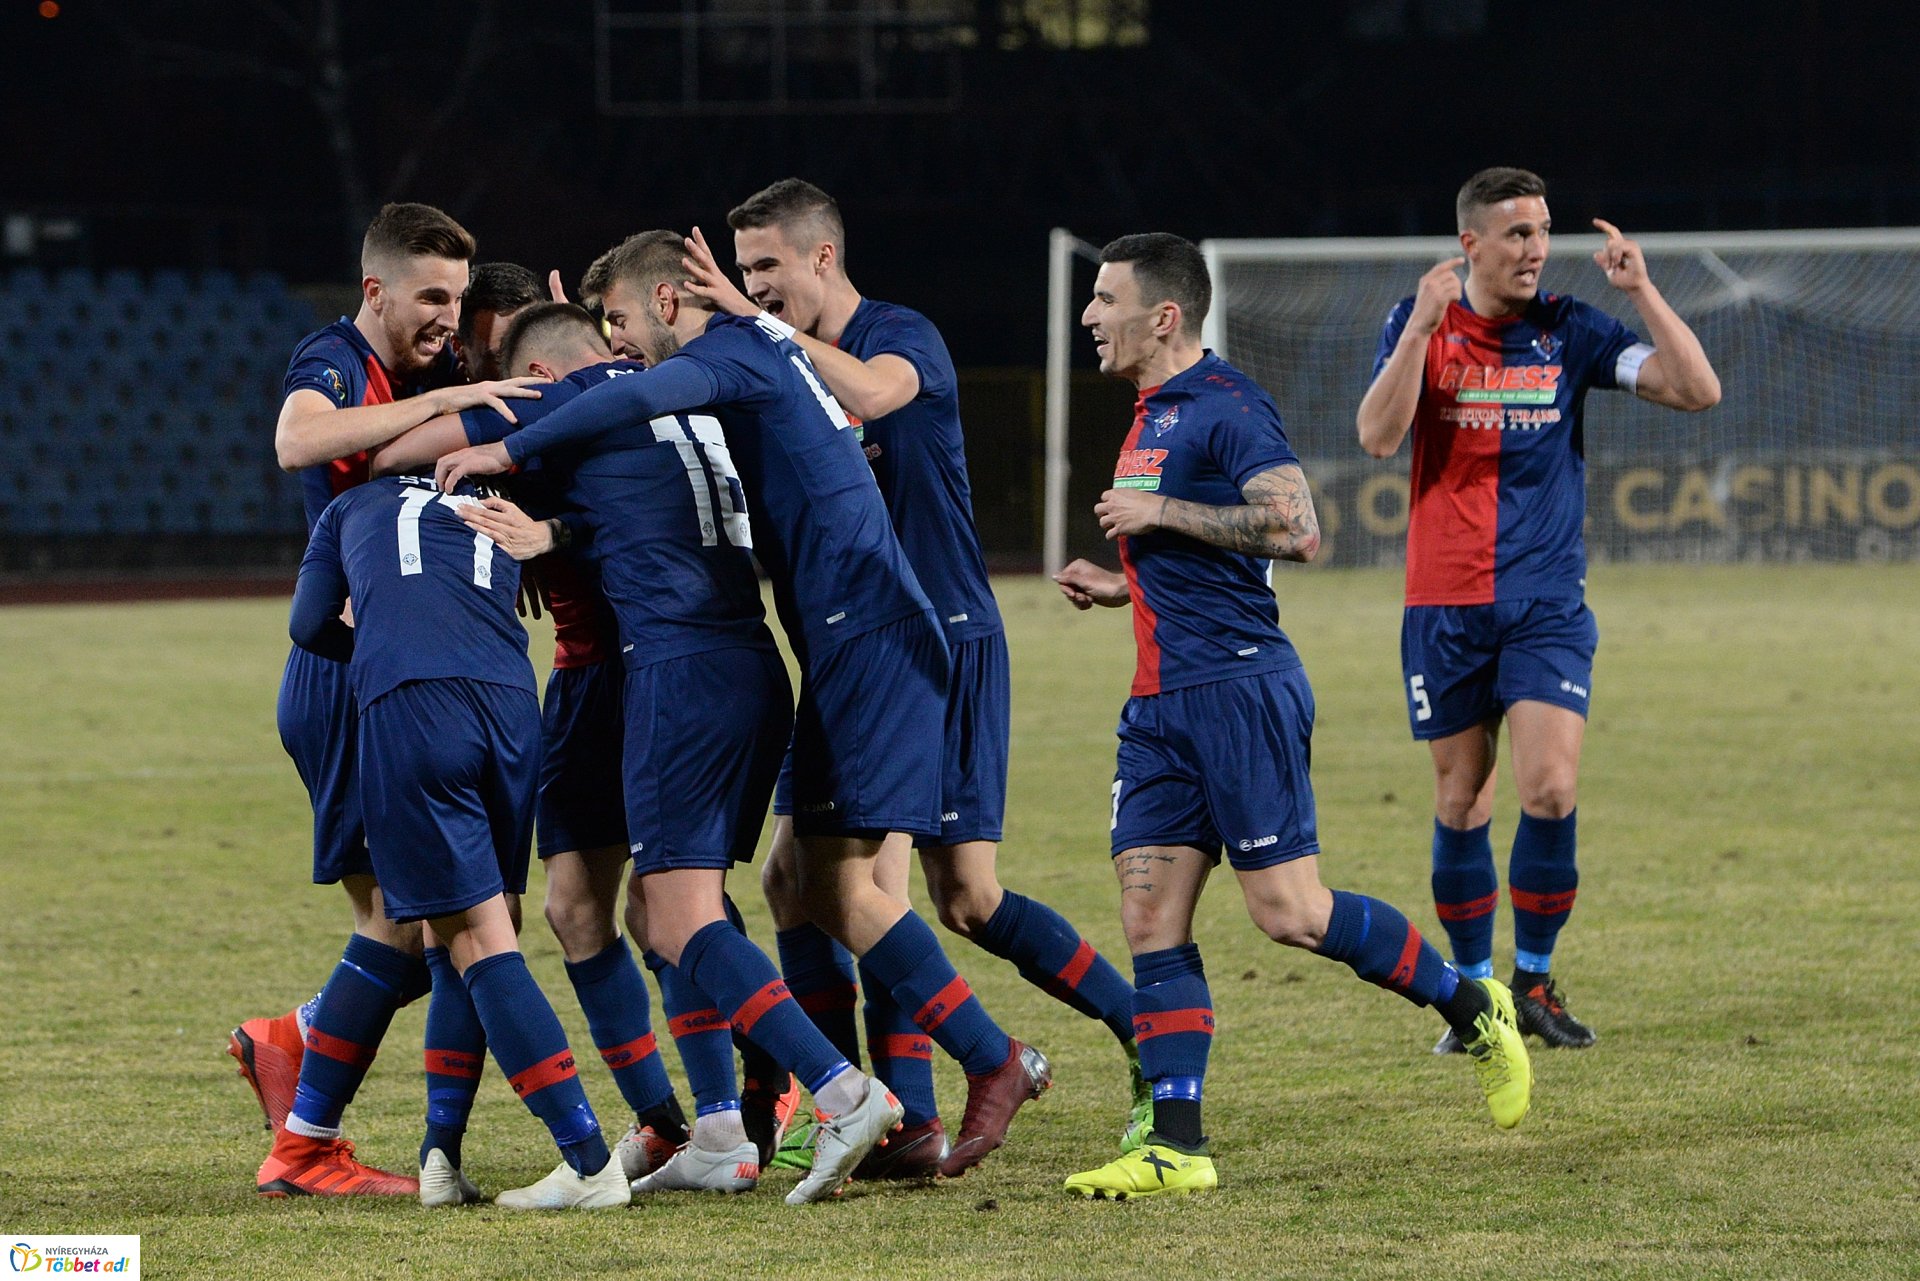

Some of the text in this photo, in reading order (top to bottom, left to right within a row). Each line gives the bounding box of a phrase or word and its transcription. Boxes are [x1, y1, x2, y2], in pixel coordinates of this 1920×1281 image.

[1614, 464, 1920, 532] CASINO
[1410, 673, 1432, 721] 5
[1252, 834, 1278, 848] JAKO
